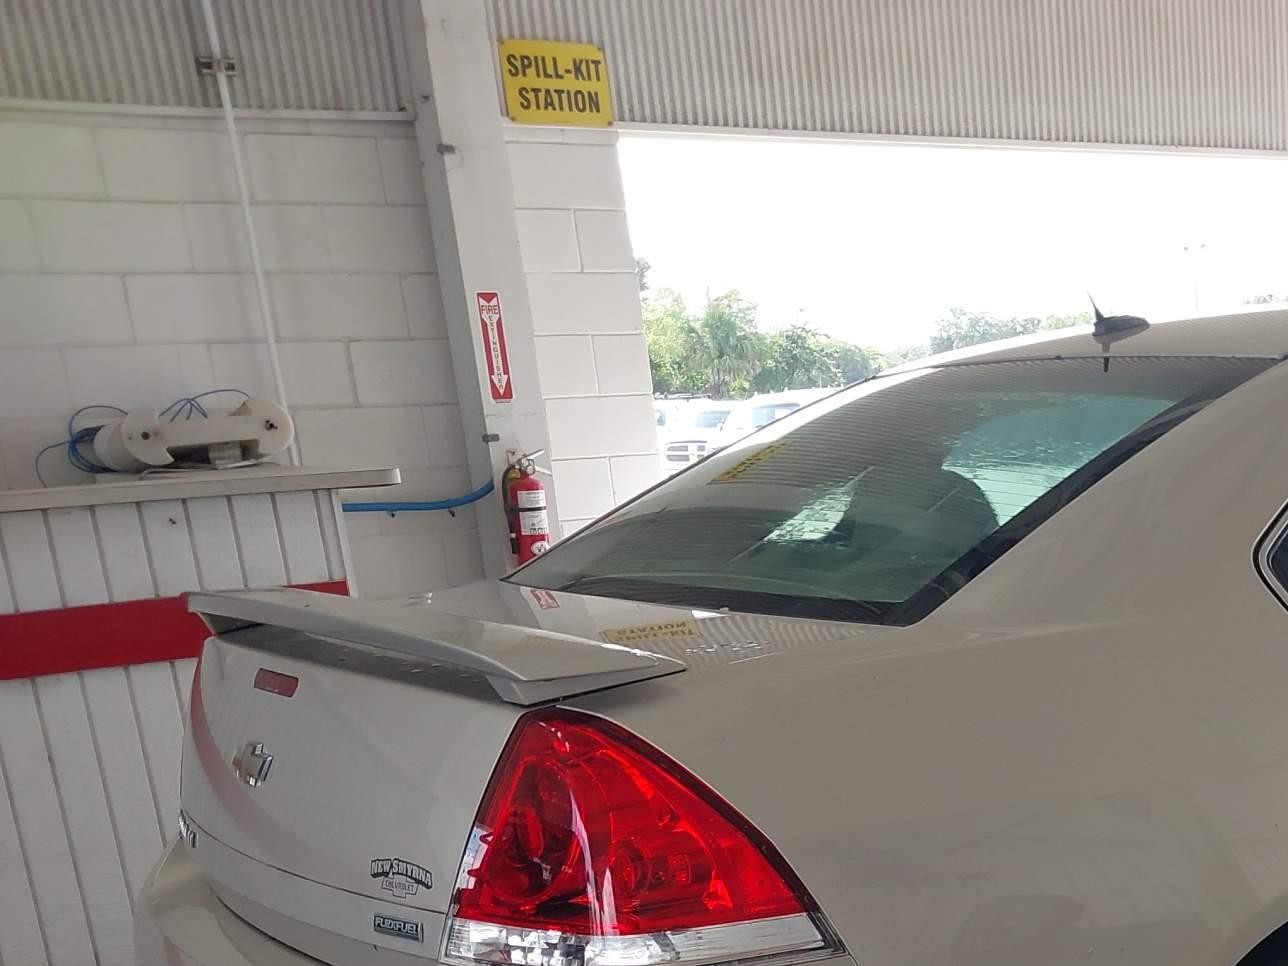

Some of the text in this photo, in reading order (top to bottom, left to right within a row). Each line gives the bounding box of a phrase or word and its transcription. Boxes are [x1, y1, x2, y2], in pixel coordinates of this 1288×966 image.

[506, 54, 602, 82] SPILL-KIT
[518, 86, 601, 113] STATION
[480, 304, 499, 315] FIRE
[488, 315, 504, 389] EXTINGUISHER
[371, 860, 432, 887] NEW SMYRNA
